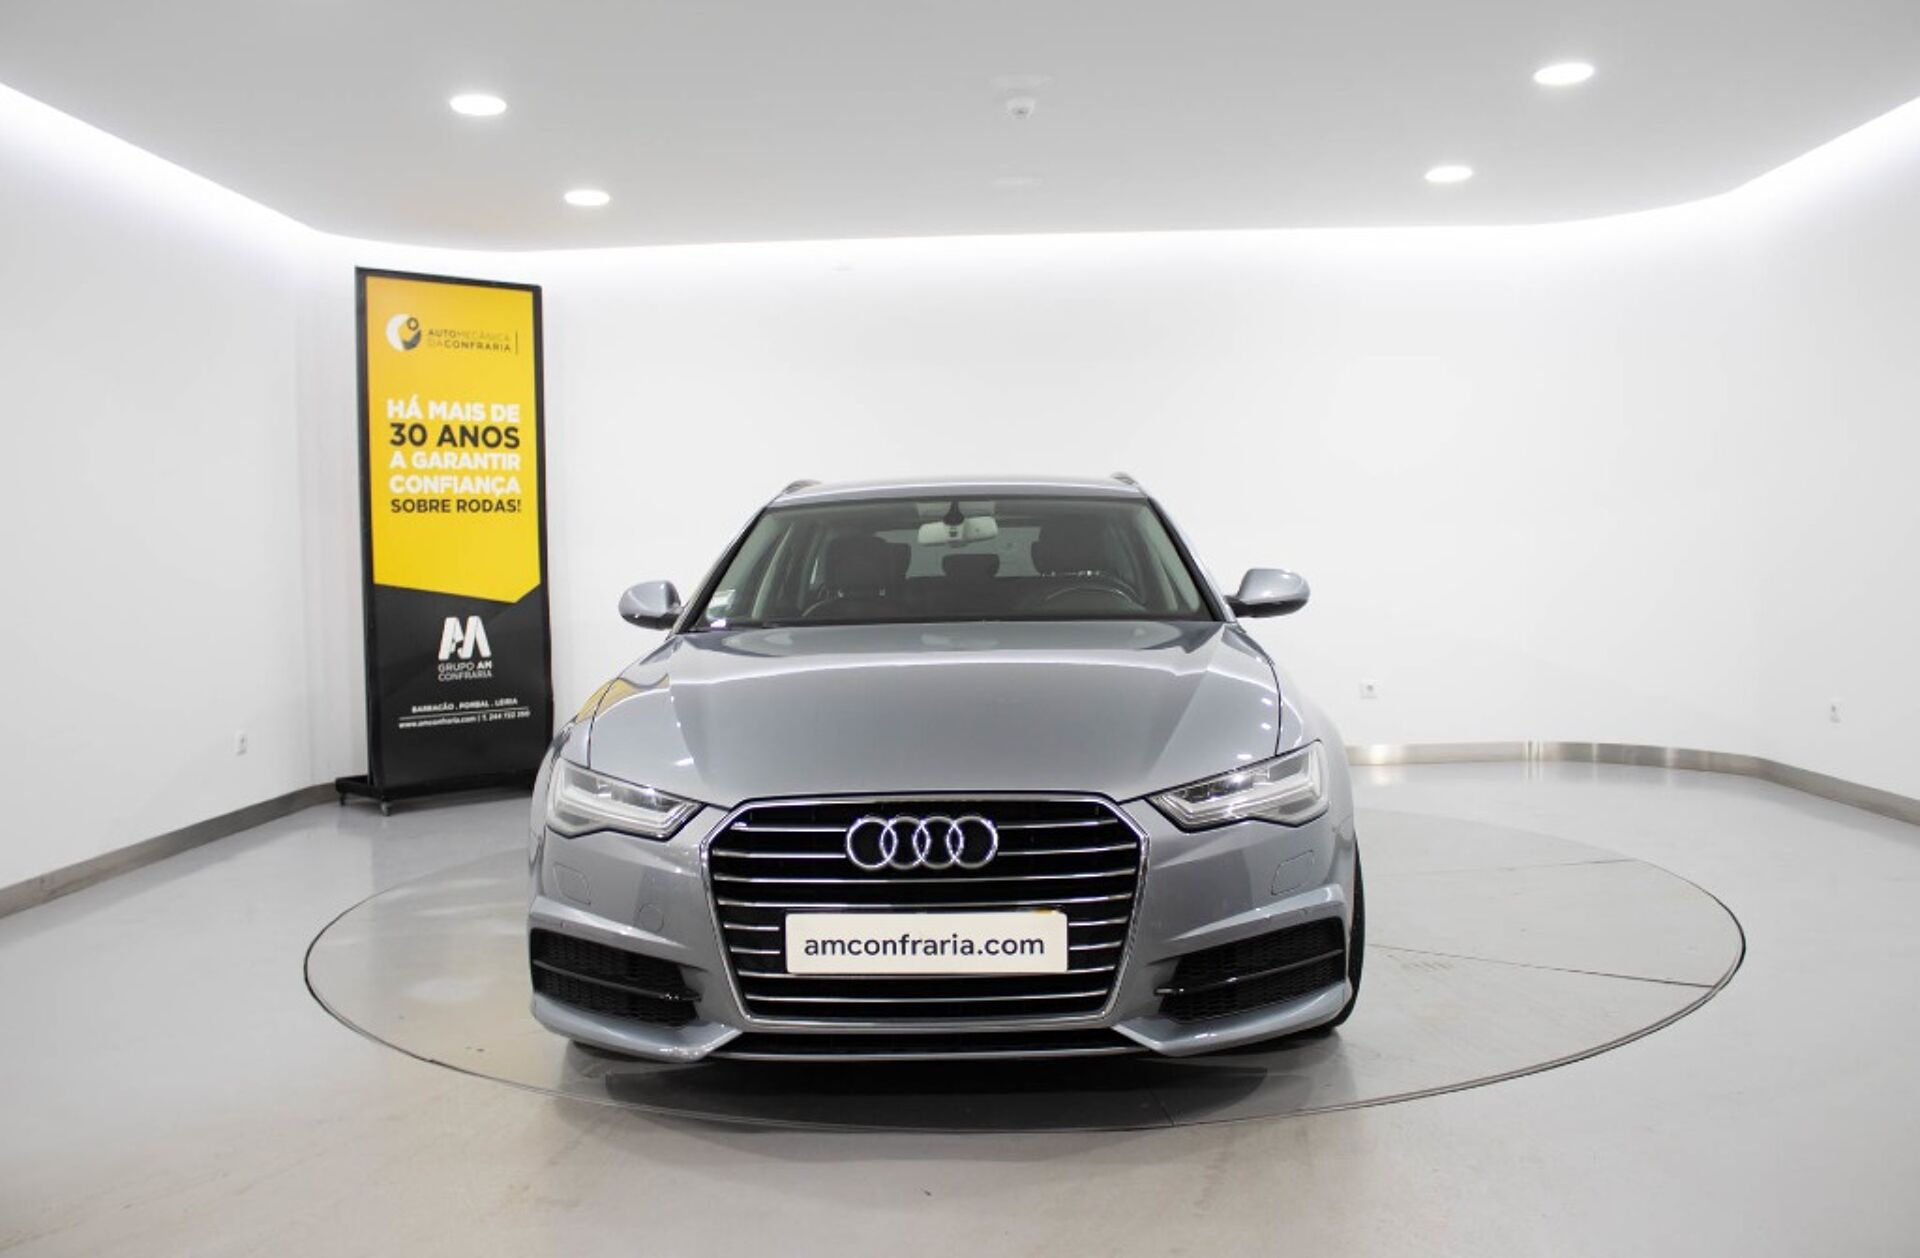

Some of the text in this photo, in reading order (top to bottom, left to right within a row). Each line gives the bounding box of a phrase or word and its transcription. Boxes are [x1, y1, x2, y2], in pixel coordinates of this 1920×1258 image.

[387, 394, 521, 423] HÁ MAIS DE
[389, 422, 520, 449] 30 ANOS
[389, 450, 521, 471] A GARANTIR
[388, 474, 522, 497] CONFIANÇA
[391, 498, 522, 514] SOBRE RODAS!
[438, 660, 492, 673] GRUPO AM
[438, 670, 492, 682] CONFRARIA
[804, 934, 1045, 956] amconfraria.com
